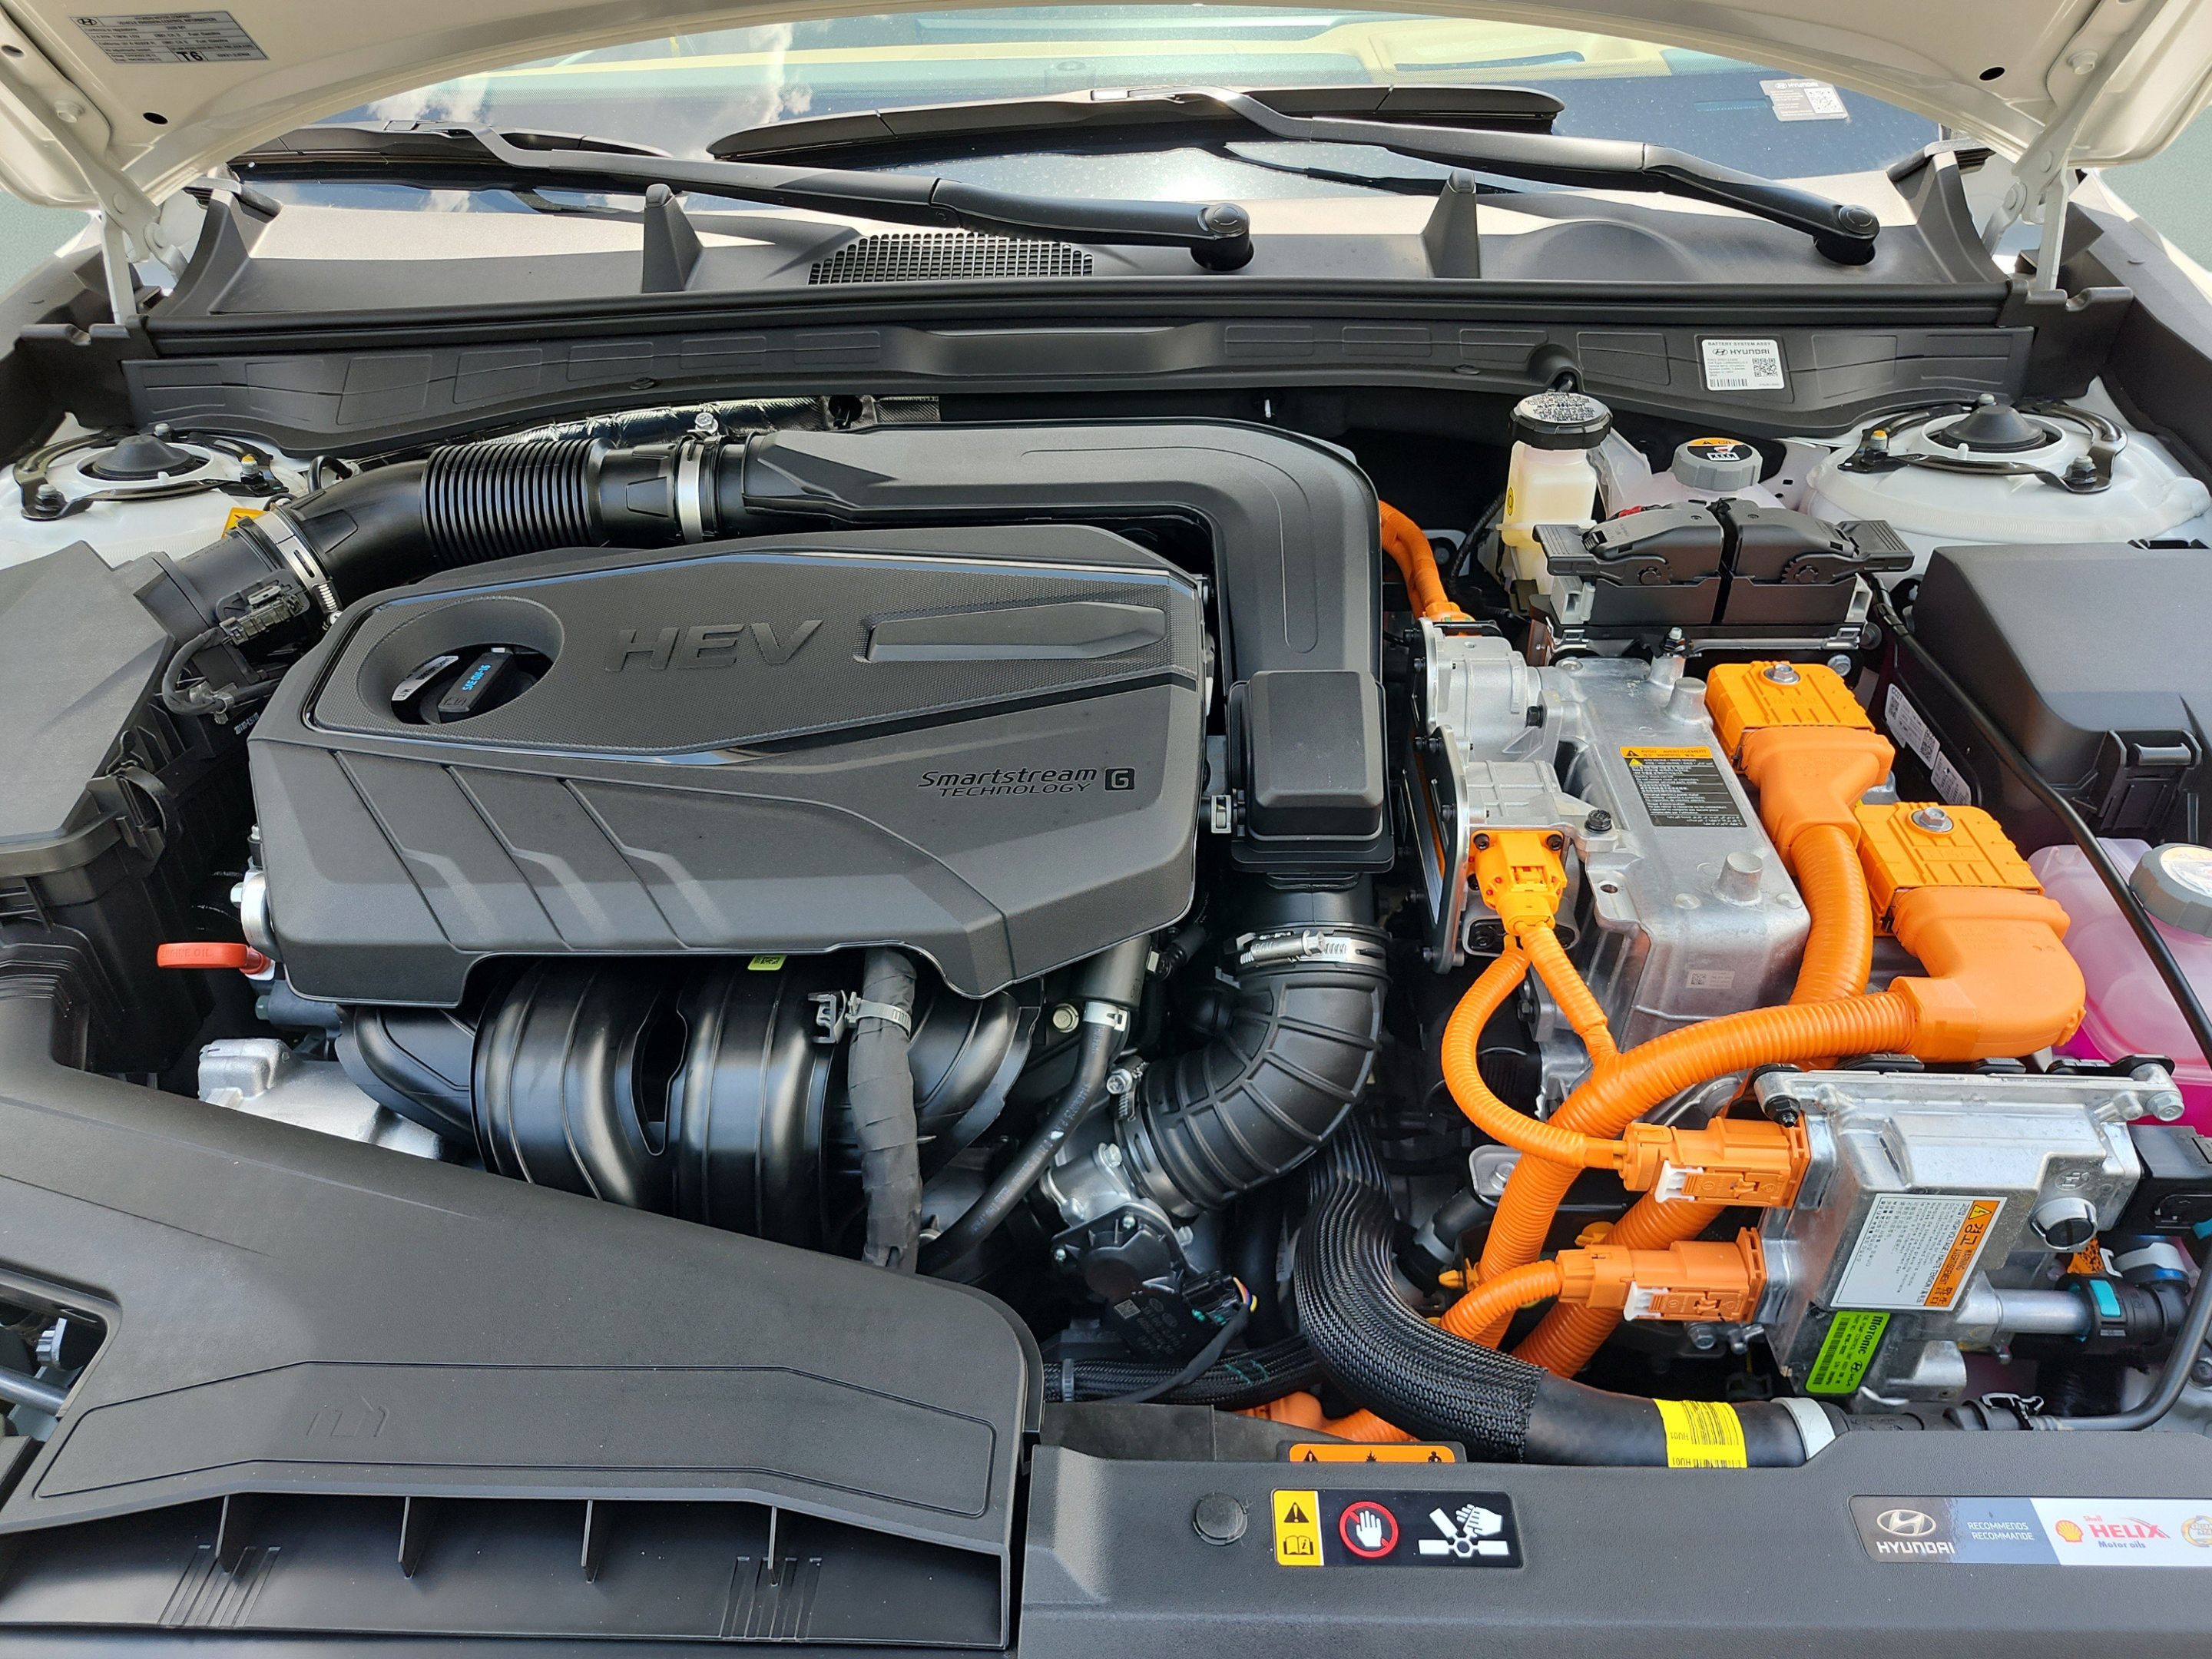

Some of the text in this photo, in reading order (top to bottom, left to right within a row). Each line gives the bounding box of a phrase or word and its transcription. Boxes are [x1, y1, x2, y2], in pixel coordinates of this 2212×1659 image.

[177, 51, 203, 61] T6
[605, 620, 823, 672] HEV
[918, 768, 1097, 788] Smartstream
[939, 783, 1091, 797] TECHNOLOGY
[194, 949, 213, 957] OIL
[1961, 1224, 1984, 1246] 경고
[1955, 1248, 1973, 1270] WARNING
[1939, 1248, 1962, 1285] AVERTISSEMENT
[1670, 1432, 1689, 1441] HU01
[1967, 1522, 2029, 1530] RECOMMENDS
[2088, 1524, 2166, 1538] HELIX
[1971, 1532, 2034, 1541] RECOMMANDE
[1876, 1541, 1955, 1555] HYUNDAI
